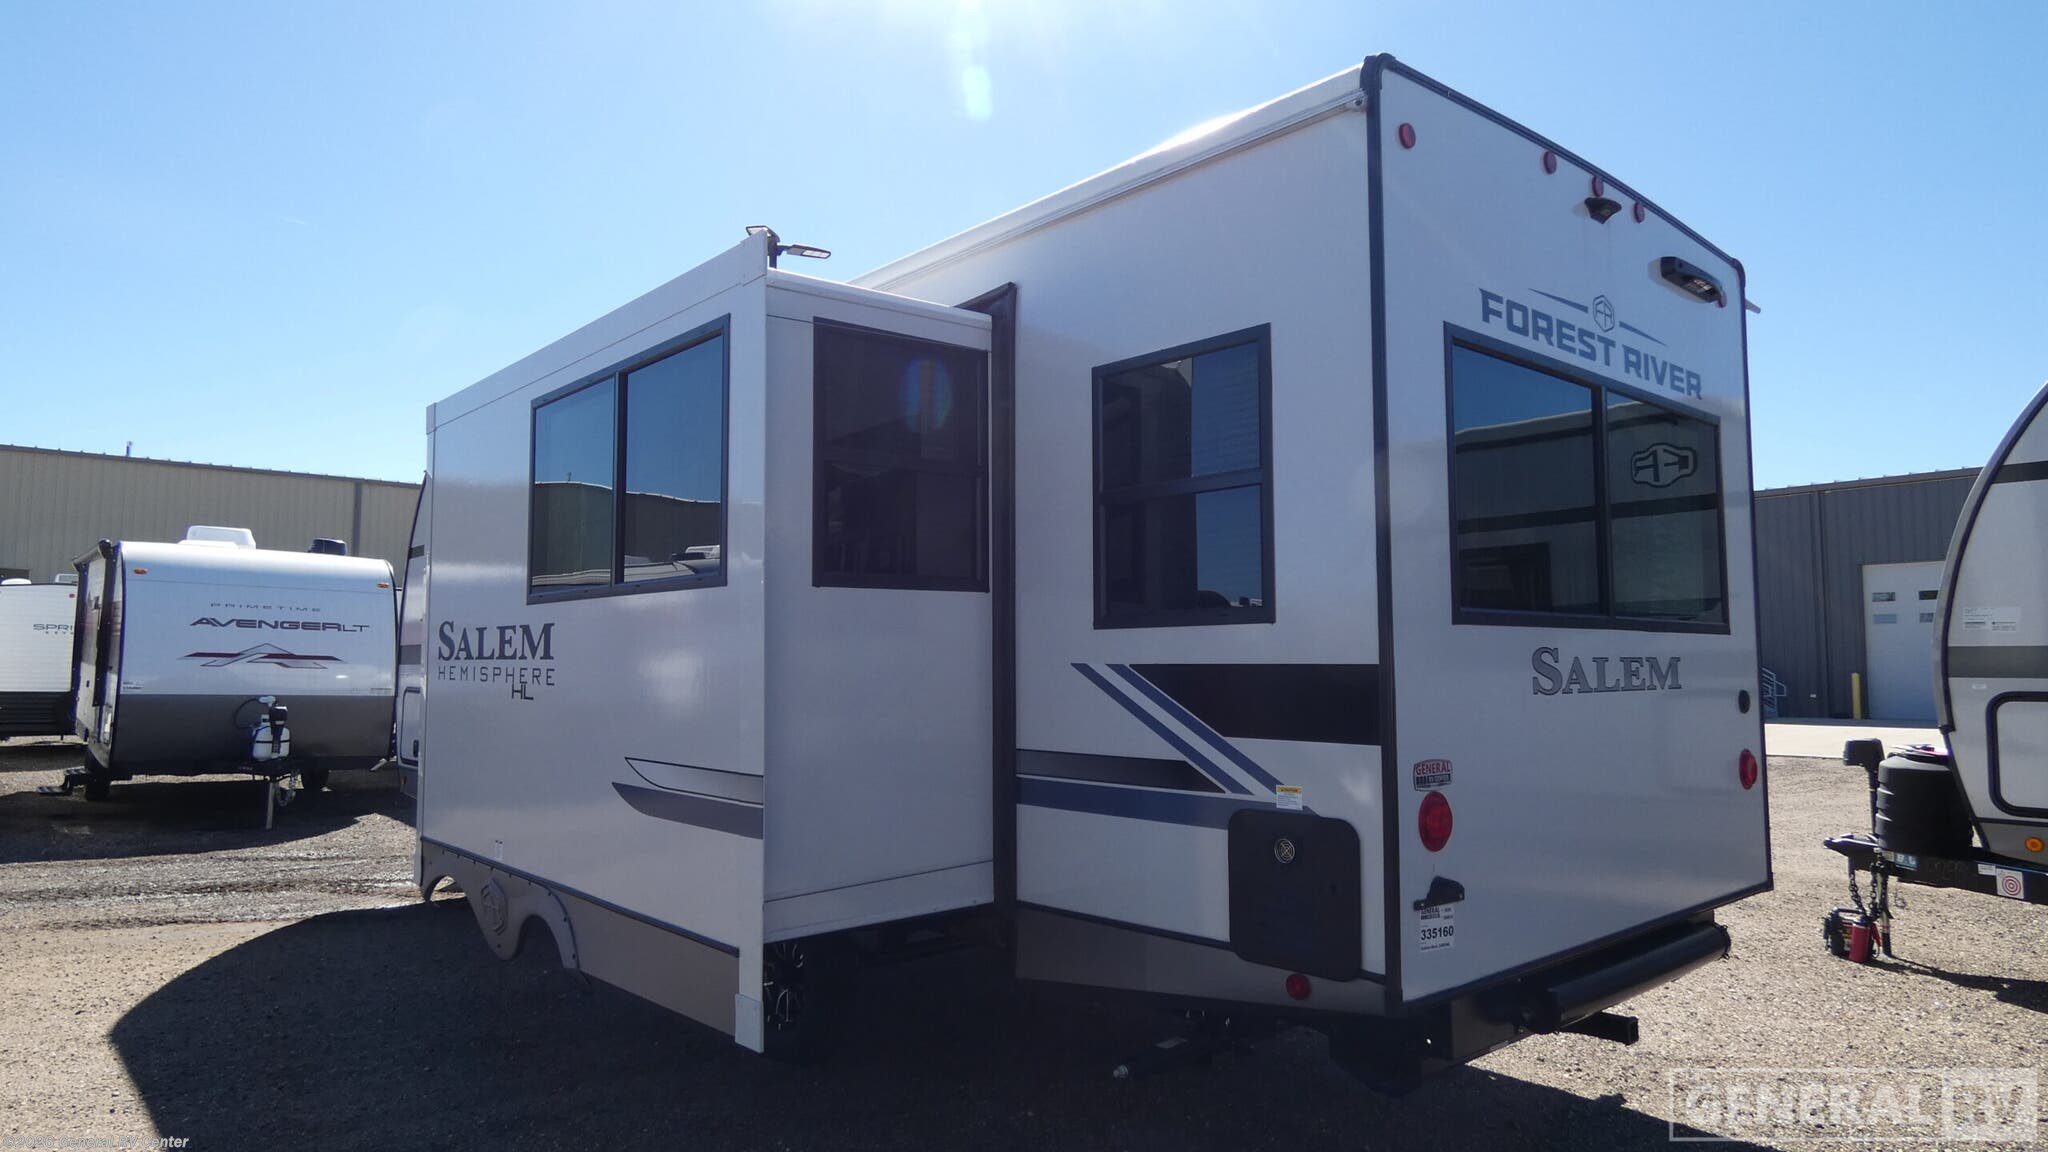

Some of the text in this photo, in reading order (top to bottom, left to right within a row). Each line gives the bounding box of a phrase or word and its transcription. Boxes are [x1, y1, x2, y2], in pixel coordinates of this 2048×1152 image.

[1479, 287, 1703, 400] FOREST RIVER
[438, 665, 555, 686] HEMISPHERE
[511, 682, 534, 700] HL
[1415, 761, 1451, 776] GENERAL
[1420, 925, 1454, 941] 335160
